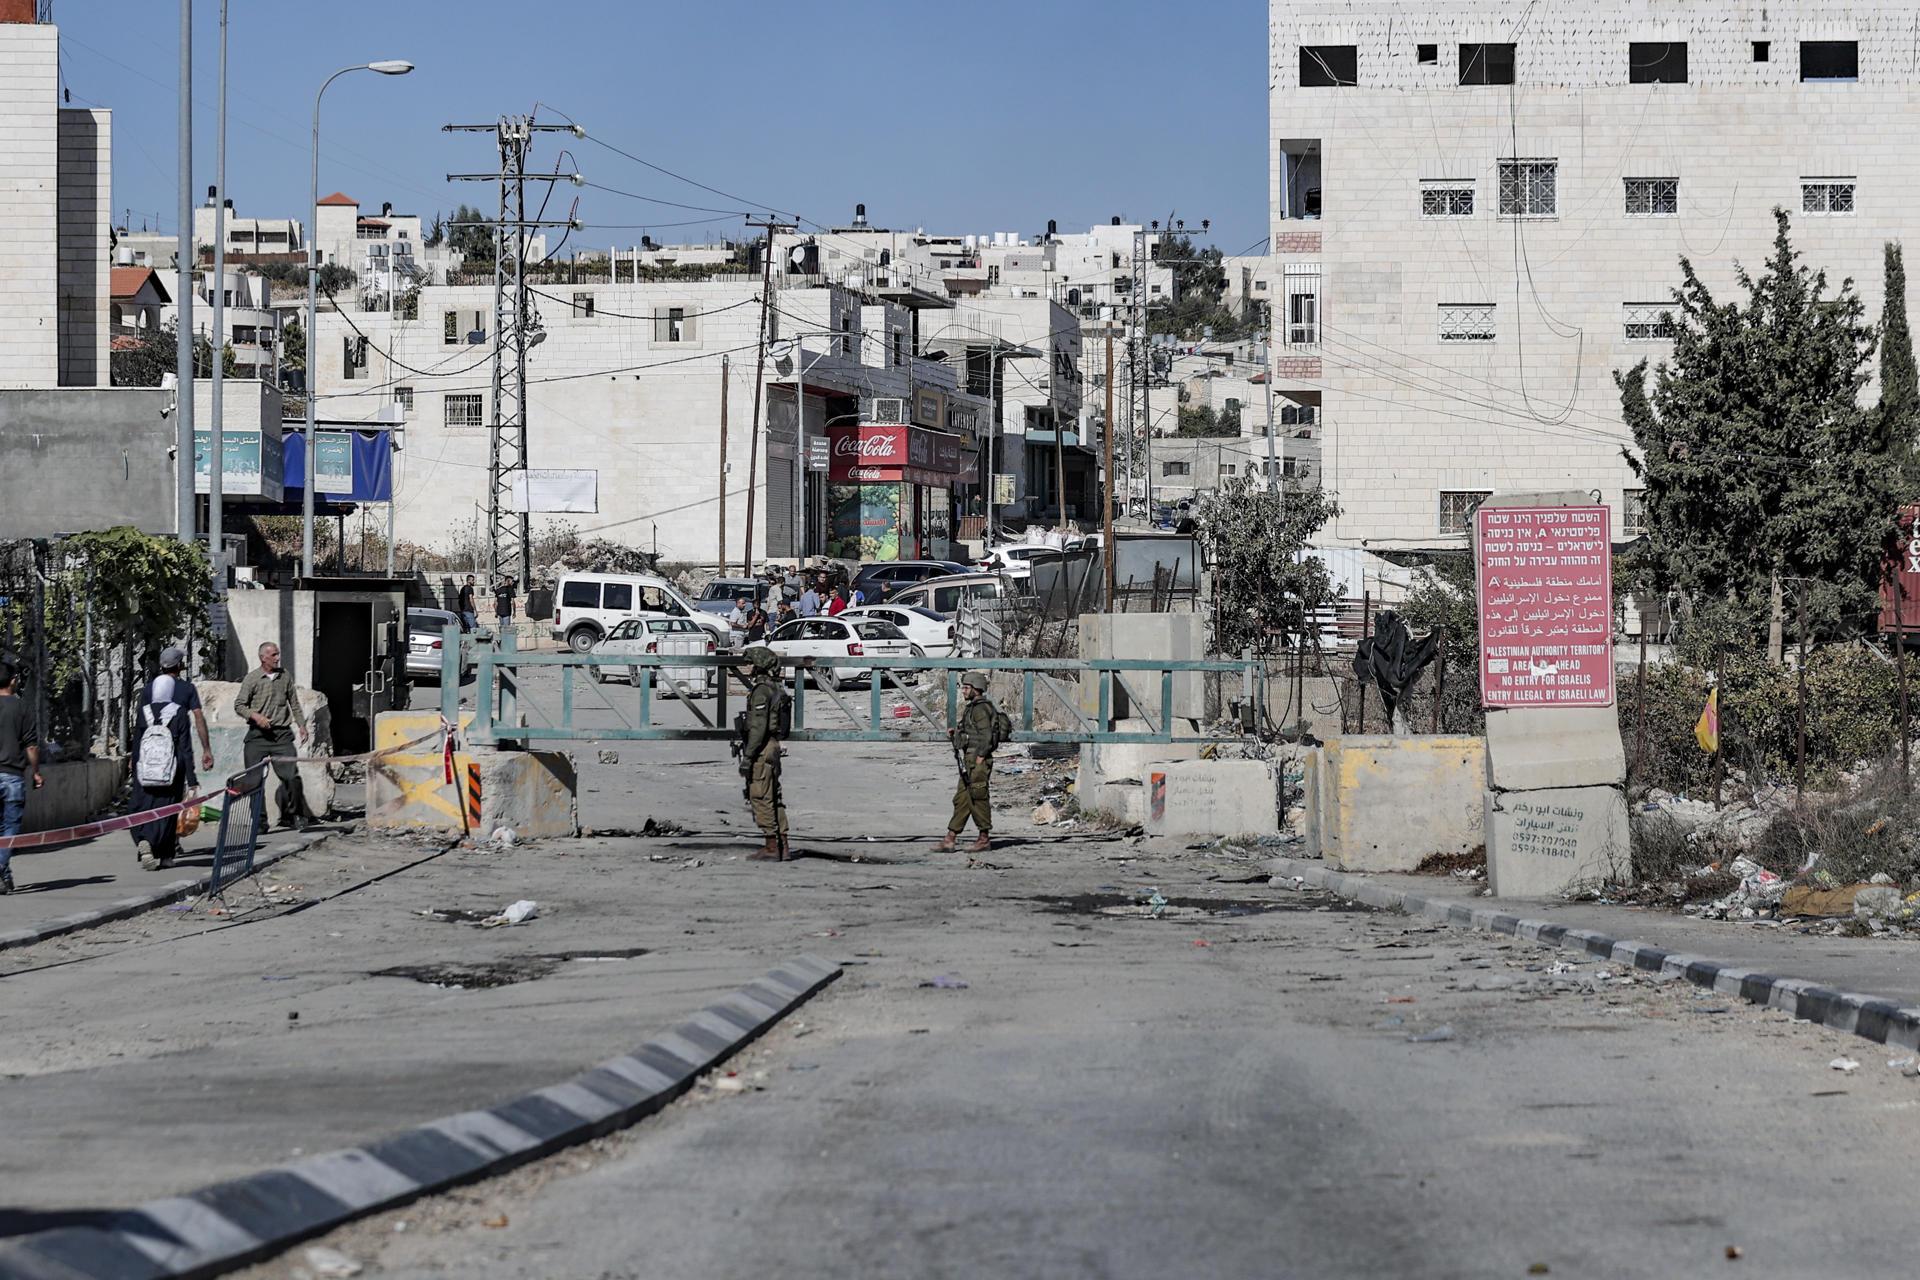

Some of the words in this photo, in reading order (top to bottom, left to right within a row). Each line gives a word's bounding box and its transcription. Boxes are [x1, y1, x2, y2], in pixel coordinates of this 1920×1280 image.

[835, 435, 897, 457] Coca-Cola
[1487, 514, 1510, 524] שטח
[1514, 514, 1532, 524] הינו
[1535, 512, 1568, 525] שלפניך
[1571, 513, 1600, 523] השטח
[1487, 528, 1514, 538] כניסה
[1517, 528, 1532, 539] אין
[1550, 526, 1601, 538] פליסטינאי
[1484, 541, 1513, 553] לשטח
[1516, 542, 1543, 552] כניסה
[1557, 541, 1604, 552] לישראלים
[1487, 557, 1511, 569] החוק
[1514, 556, 1526, 567] על
[1529, 556, 1558, 566] עבירה
[1560, 556, 1588, 566] מהווה
[1590, 555, 1601, 566] זה
[1488, 576, 1501, 588] A
[1503, 577, 1543, 589] فلسطينية
[1545, 576, 1573, 587] منطقة
[1576, 574, 1602, 587] أمامك
[1544, 592, 1570, 604] دخول
[1572, 593, 1603, 606] ممنوع
[1485, 608, 1502, 619] هذه
[1578, 607, 1605, 620] دخول
[1487, 624, 1519, 638] للقانون
[1571, 623, 1604, 634] المنطقة
[1486, 646, 1530, 657] PALESTINIAN
[1531, 645, 1568, 656] AUTHORITY
[1570, 644, 1606, 656] TERRITORY
[1555, 660, 1580, 671] AHEAD
[1501, 675, 1513, 687] NO
[1514, 674, 1538, 686] ENTRY
[1541, 674, 1556, 686] FOR
[1557, 674, 1591, 686] ISRAELIS
[1487, 690, 1511, 701] ENTRY
[1514, 690, 1543, 701] ILLEGAL
[1545, 689, 1556, 700] BY
[1557, 688, 1587, 700] ISRAELI
[1589, 688, 1606, 699] LAW
